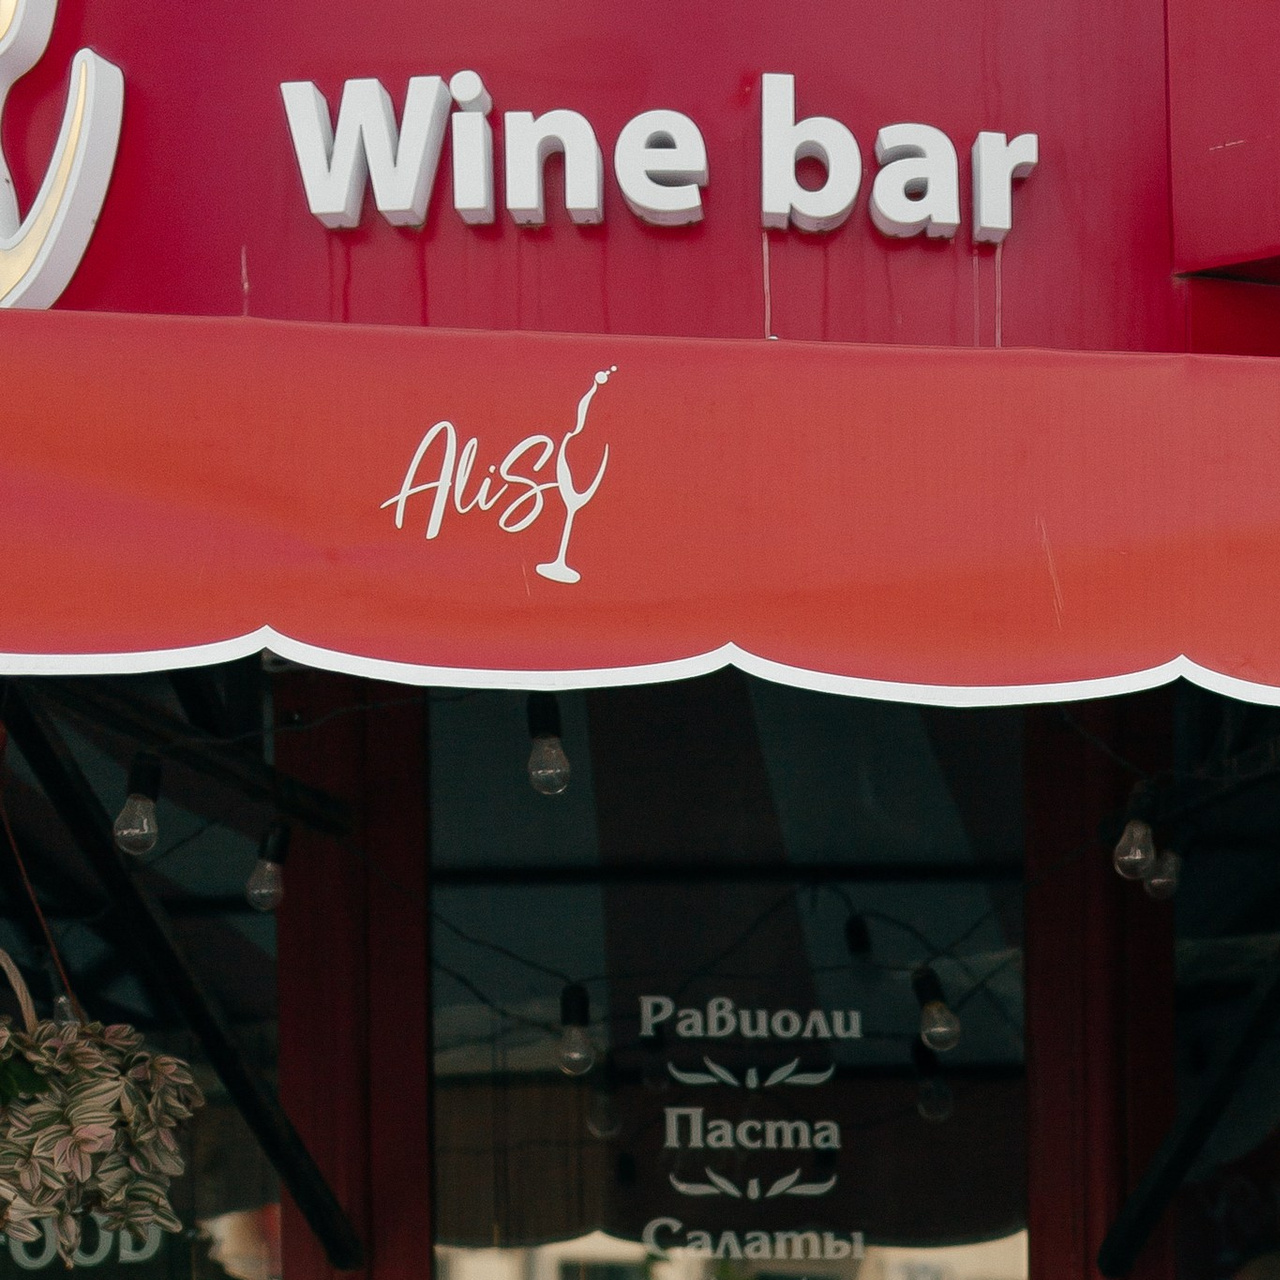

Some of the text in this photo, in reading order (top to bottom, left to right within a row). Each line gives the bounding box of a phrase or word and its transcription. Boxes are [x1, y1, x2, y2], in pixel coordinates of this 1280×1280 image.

[280, 70, 709, 230] Wine
[760, 72, 1040, 245] bar
[638, 995, 864, 1039] Равиоли
[663, 1107, 842, 1150] Паста
[0, 1208, 163, 1270] OOD
[641, 1216, 865, 1260] Салаты
